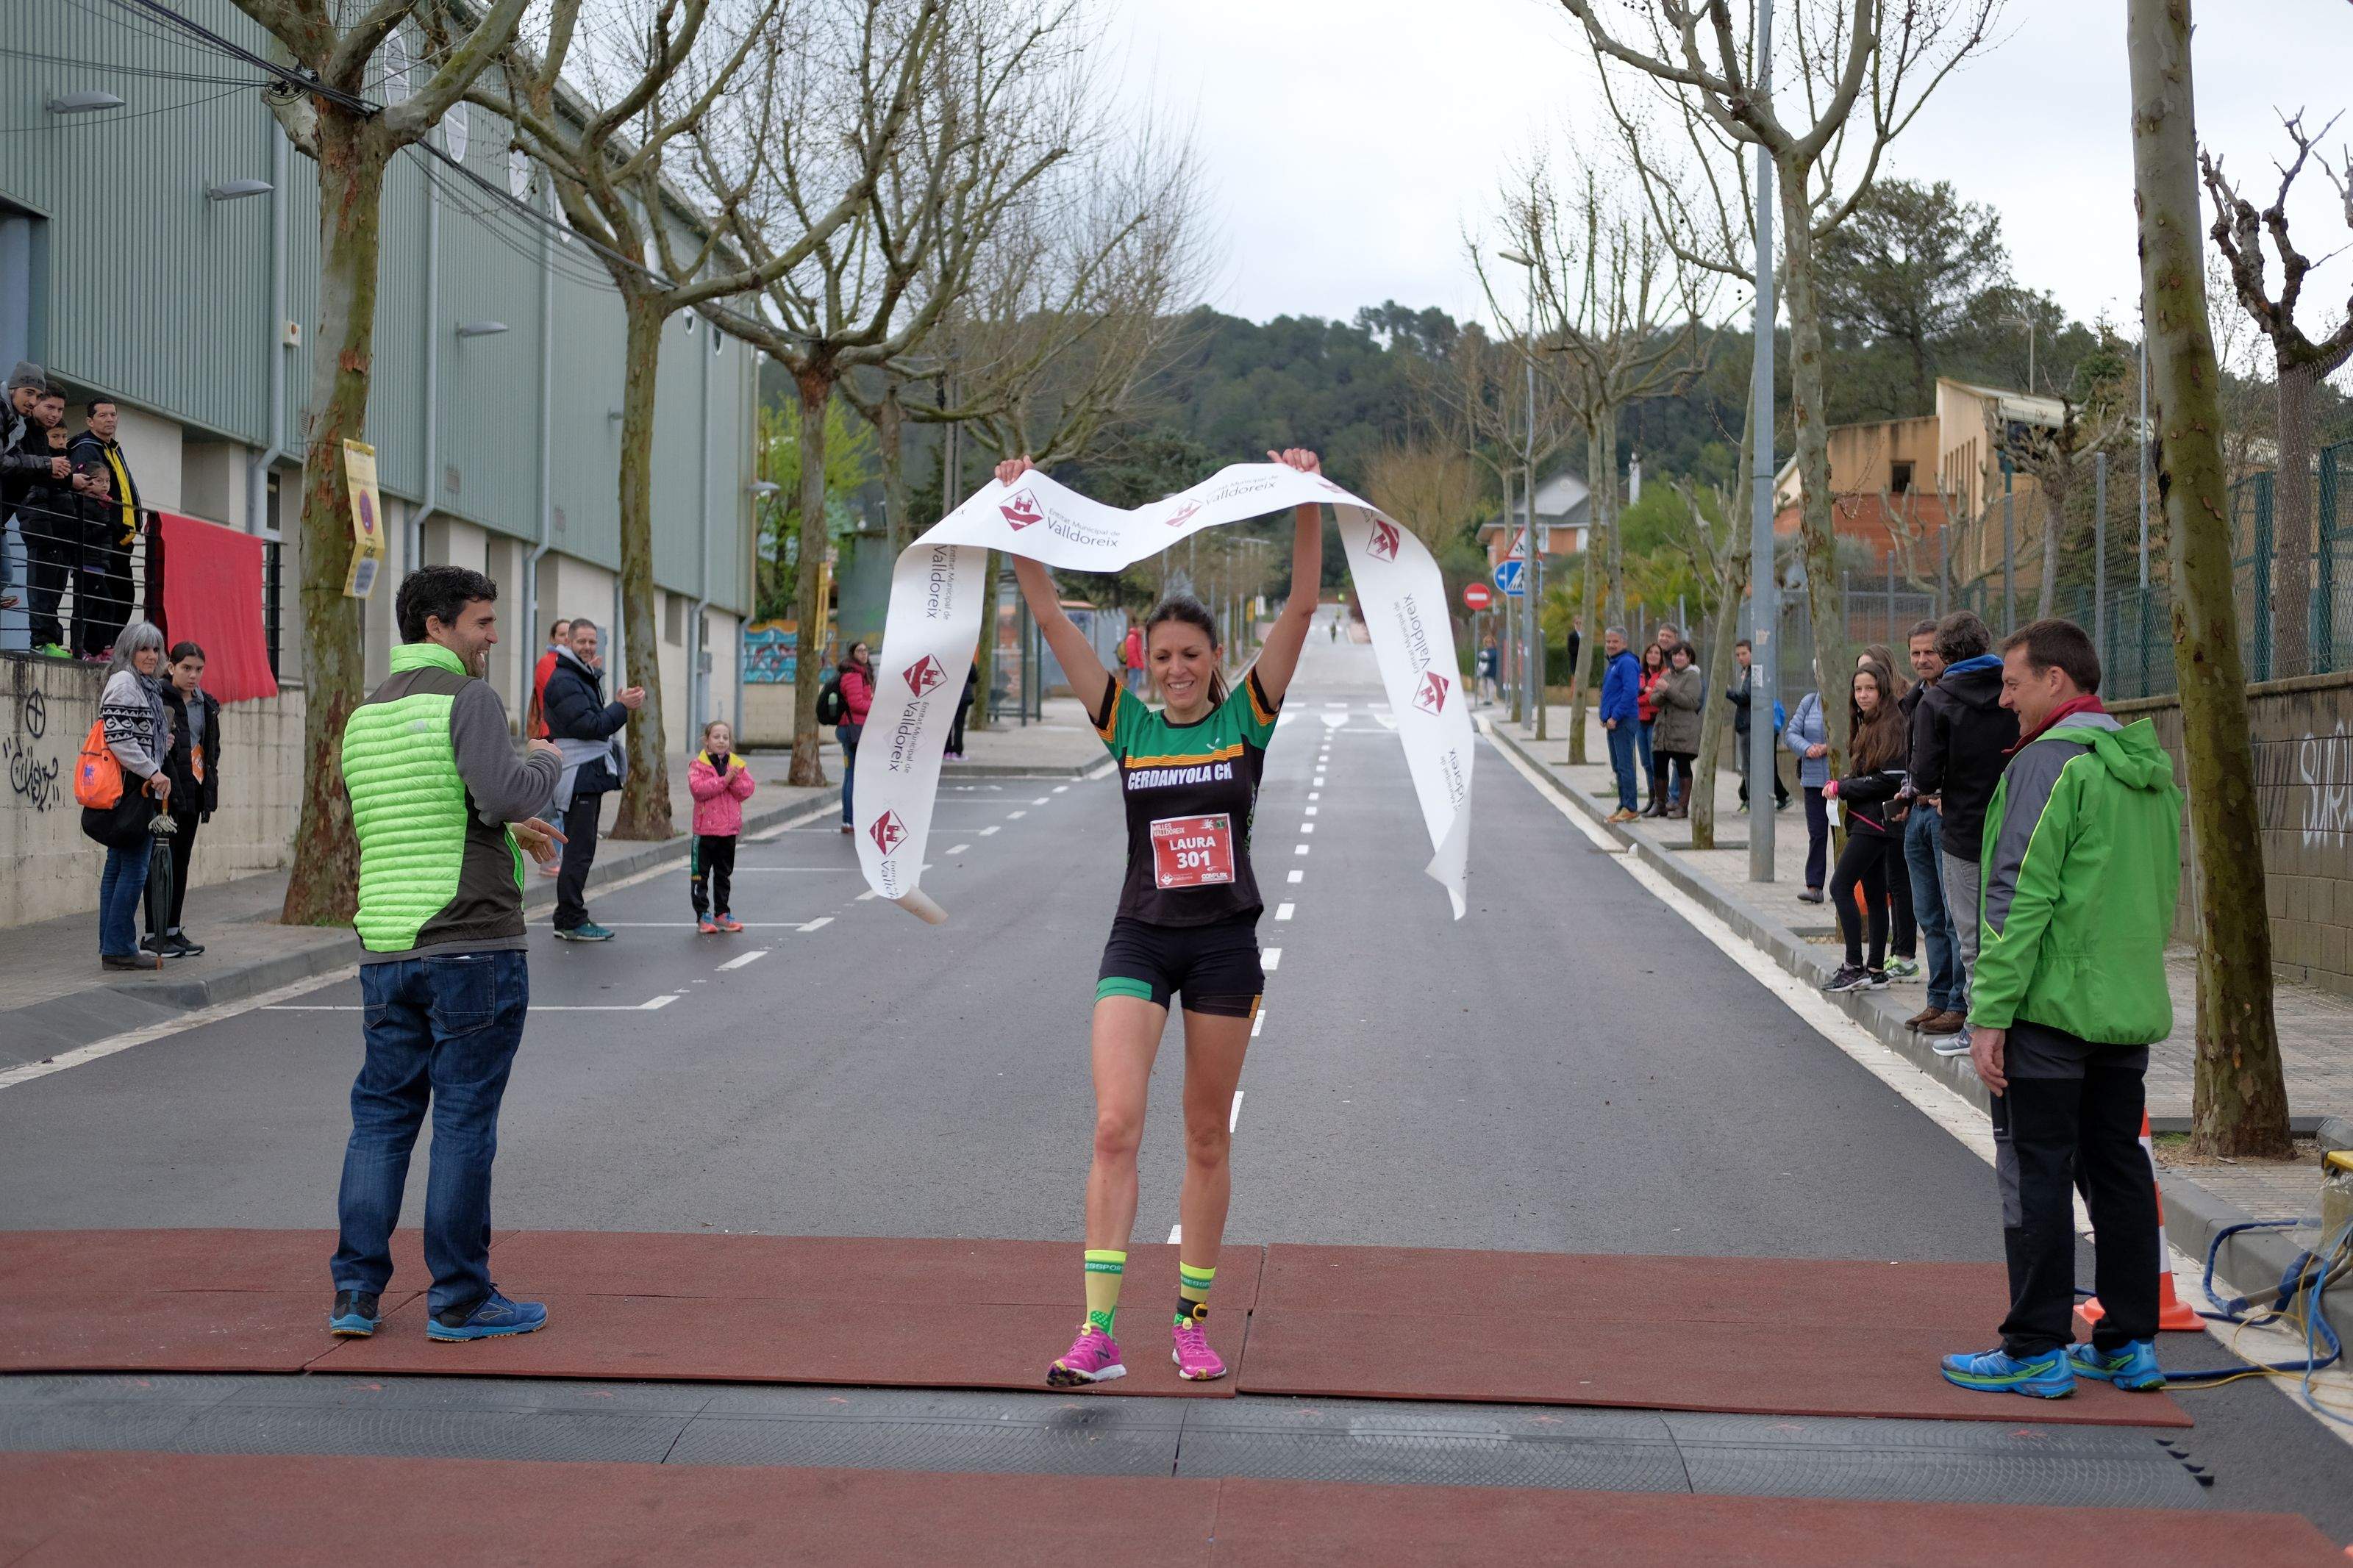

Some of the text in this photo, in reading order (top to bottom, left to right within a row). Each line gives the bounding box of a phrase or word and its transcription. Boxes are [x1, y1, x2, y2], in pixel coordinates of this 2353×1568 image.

[1206, 482, 1277, 506] Valldoreix
[1048, 516, 1118, 547] Valldoreix
[1049, 507, 1071, 524] Entitat
[1073, 520, 1108, 535] Municipal
[926, 545, 947, 619] Valldoreix
[943, 545, 958, 620] Entitat Municipal de
[1403, 593, 1431, 670] Valldoreix
[889, 701, 920, 772] Valldoreix
[904, 702, 929, 773] Entitat Municipal de
[1127, 766, 1212, 790] CERDANYOLA
[1449, 747, 1464, 806] ldoreix
[1169, 836, 1216, 851] LAURA
[1176, 850, 1211, 869] 301
